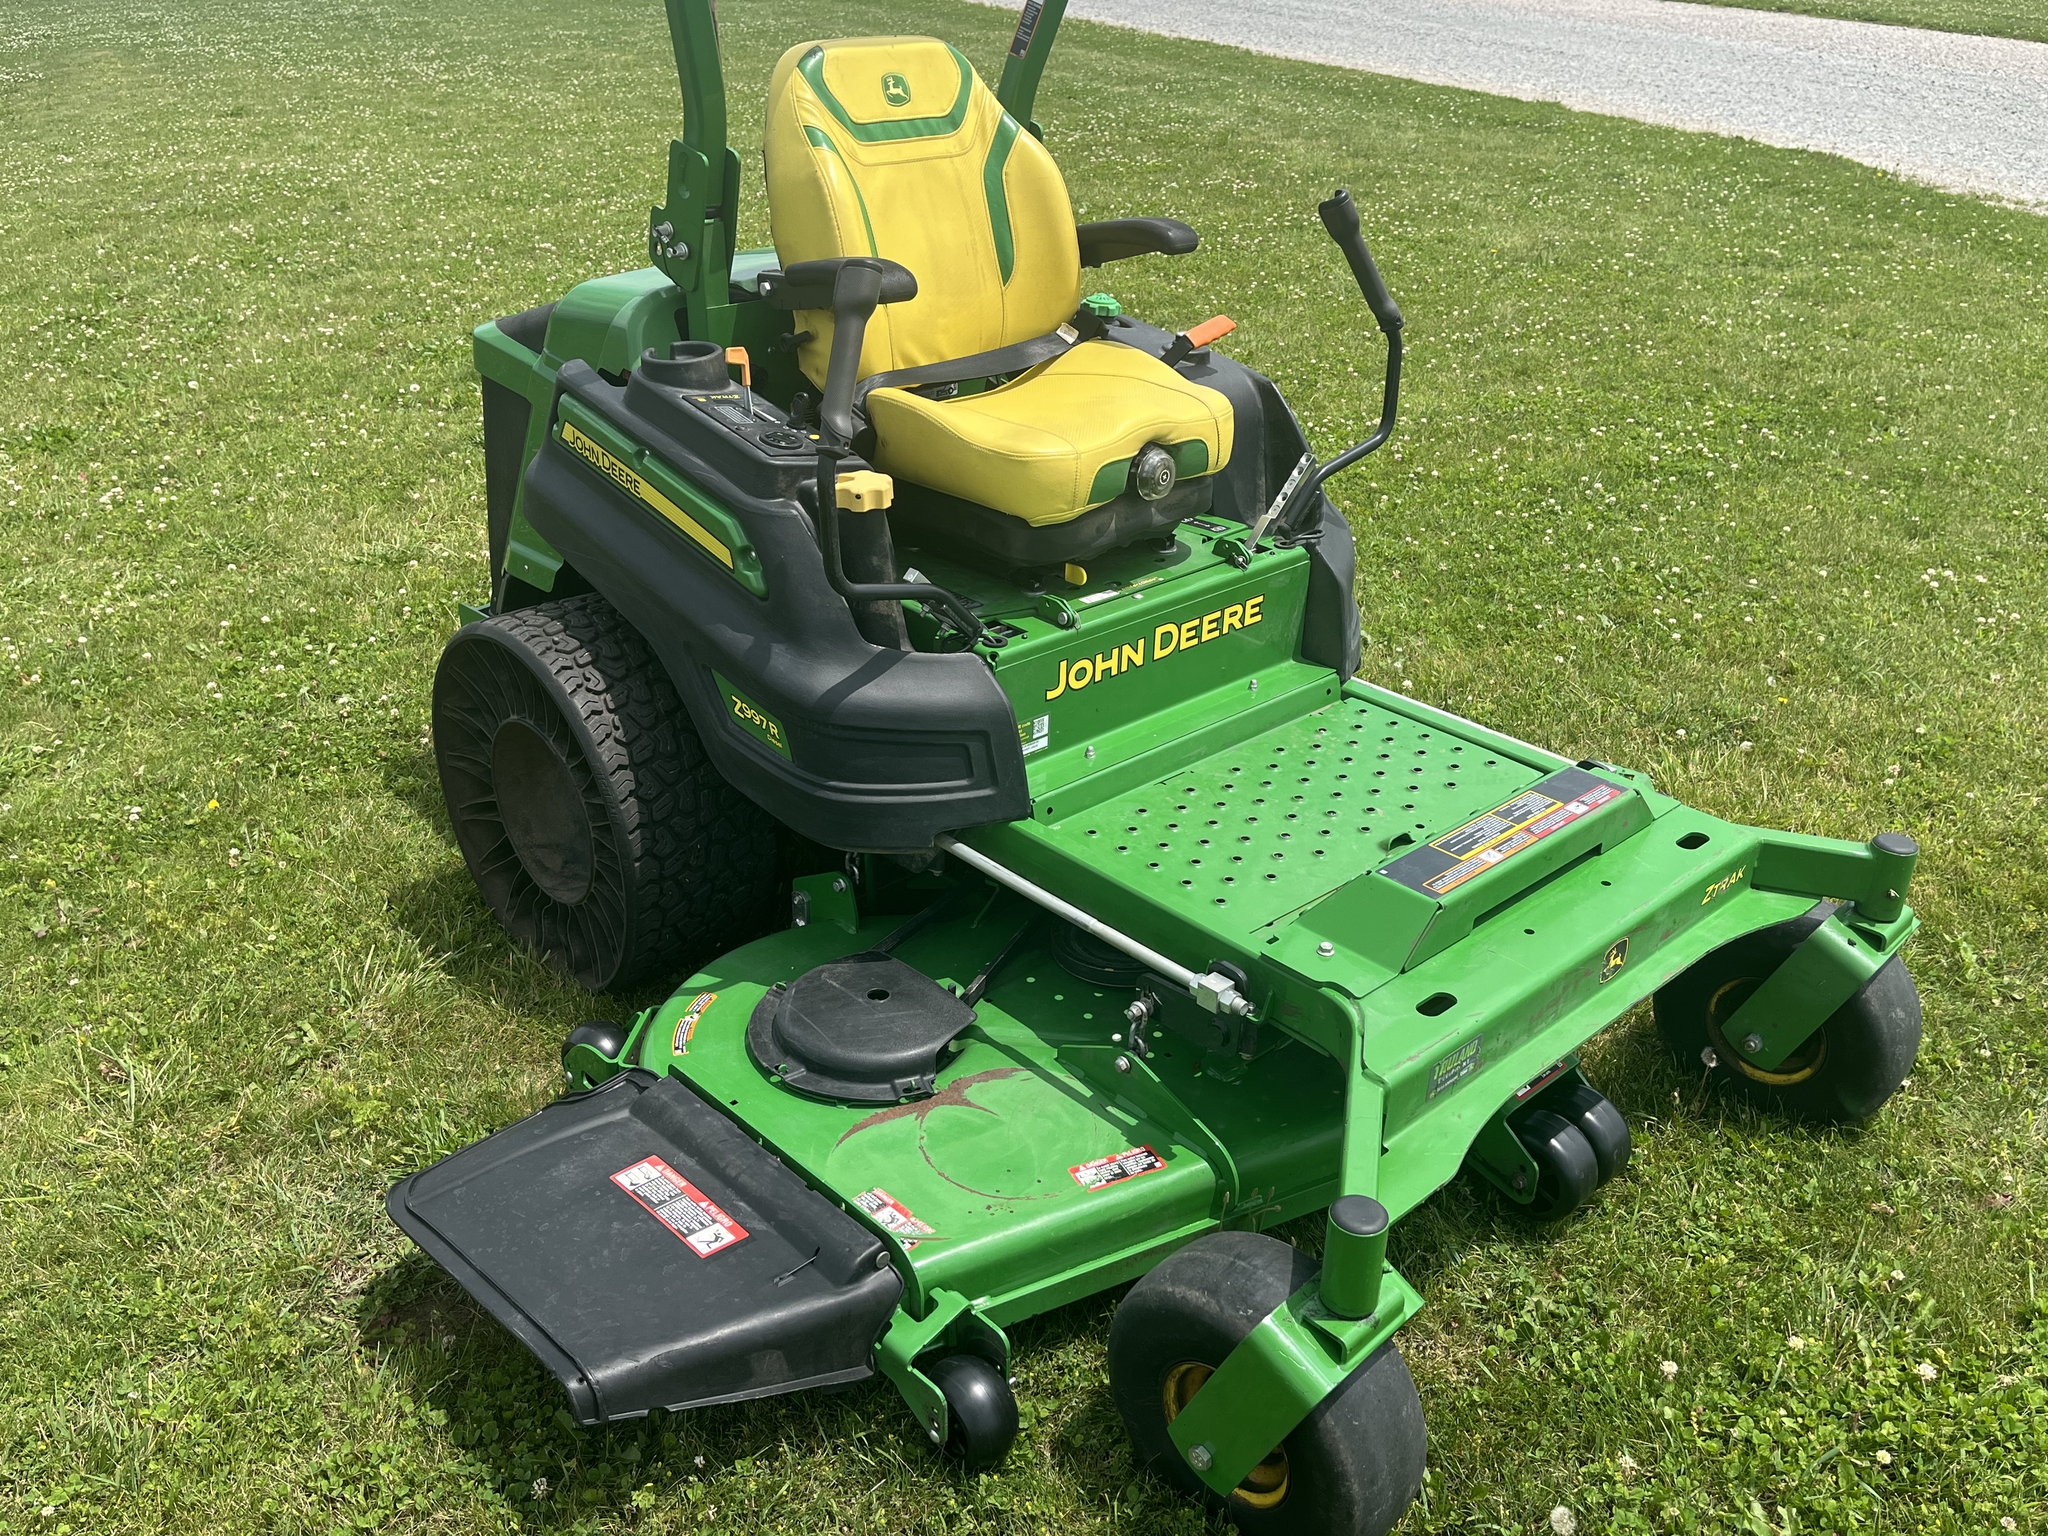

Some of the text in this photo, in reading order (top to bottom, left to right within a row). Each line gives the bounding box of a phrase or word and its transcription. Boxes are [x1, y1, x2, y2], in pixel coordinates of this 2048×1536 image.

[568, 429, 642, 497] JOHN DEERE
[1045, 594, 1265, 701] JOHN DEERE
[1702, 865, 1746, 905] ZTRAK
[663, 1168, 687, 1188] DANGER
[706, 1205, 733, 1227] PELIGRO
